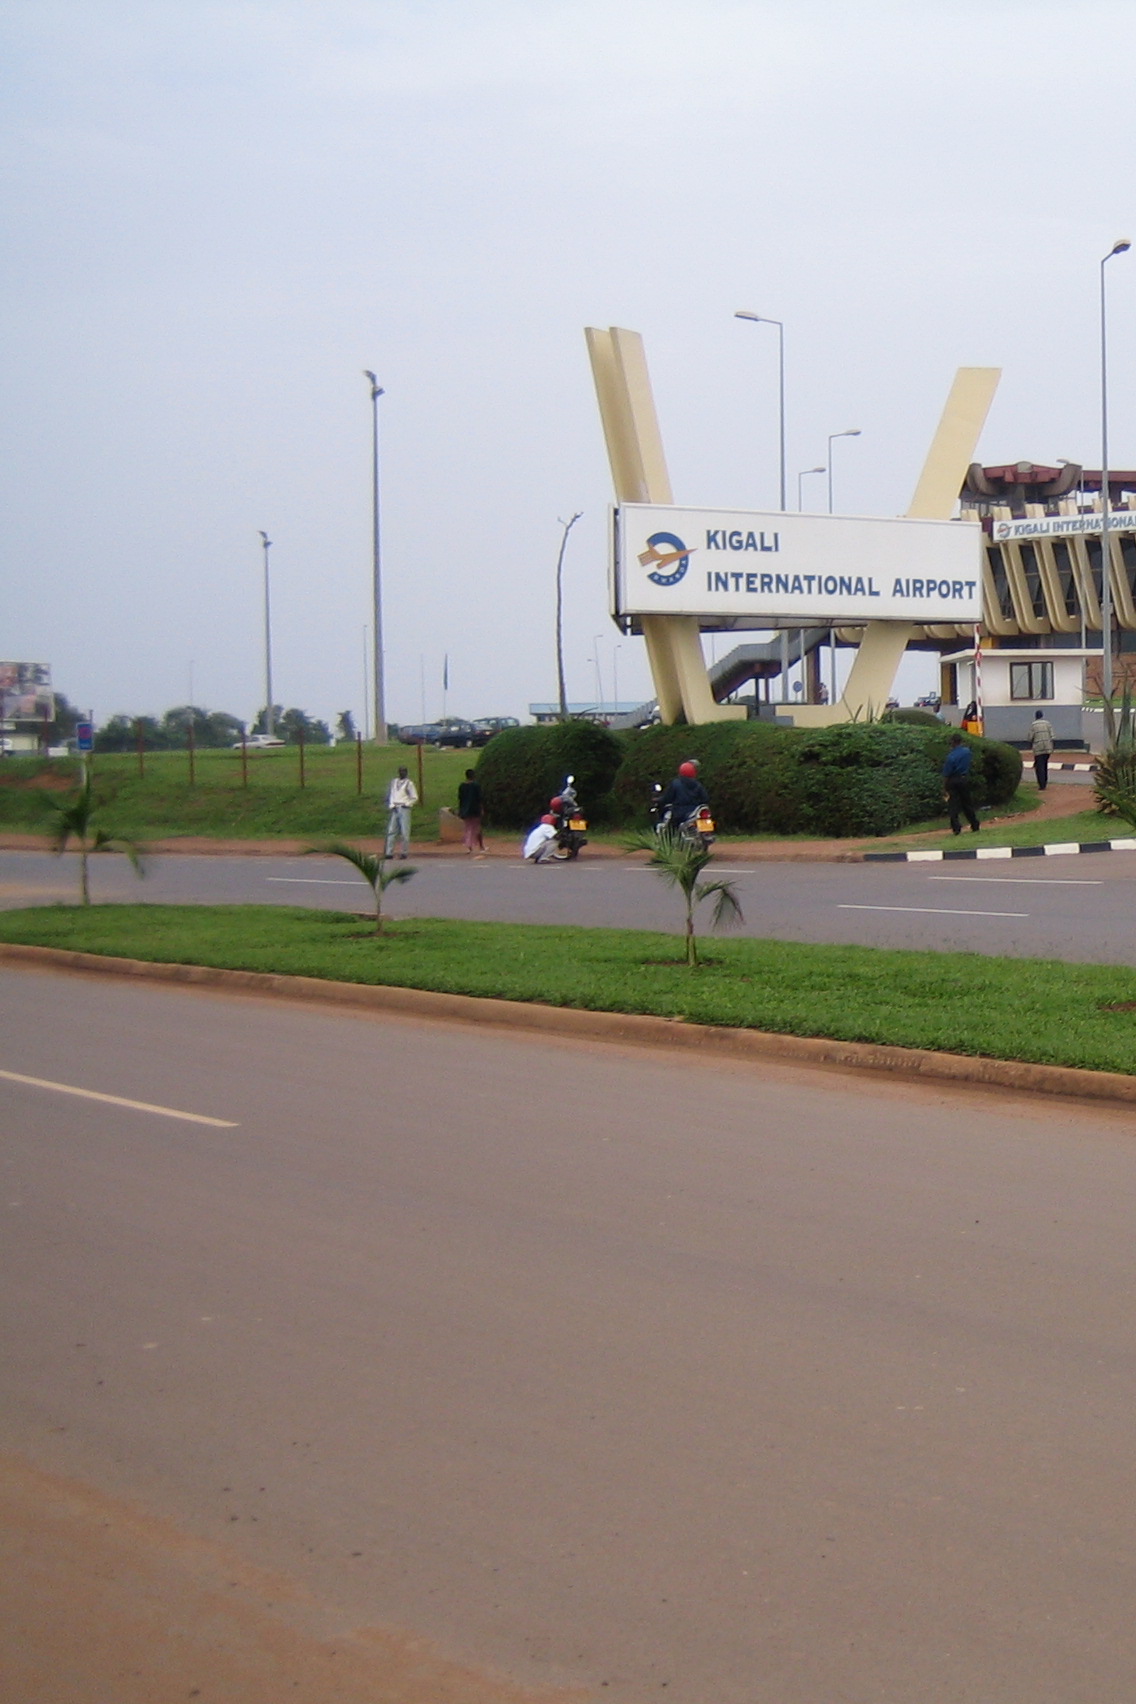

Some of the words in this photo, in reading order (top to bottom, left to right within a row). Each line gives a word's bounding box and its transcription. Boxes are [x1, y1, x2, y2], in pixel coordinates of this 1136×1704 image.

[1014, 521, 1050, 535] KIGALI
[706, 529, 780, 553] KIGALI
[706, 571, 881, 598] INTERNATIONAL
[892, 577, 977, 600] AIRPORT
